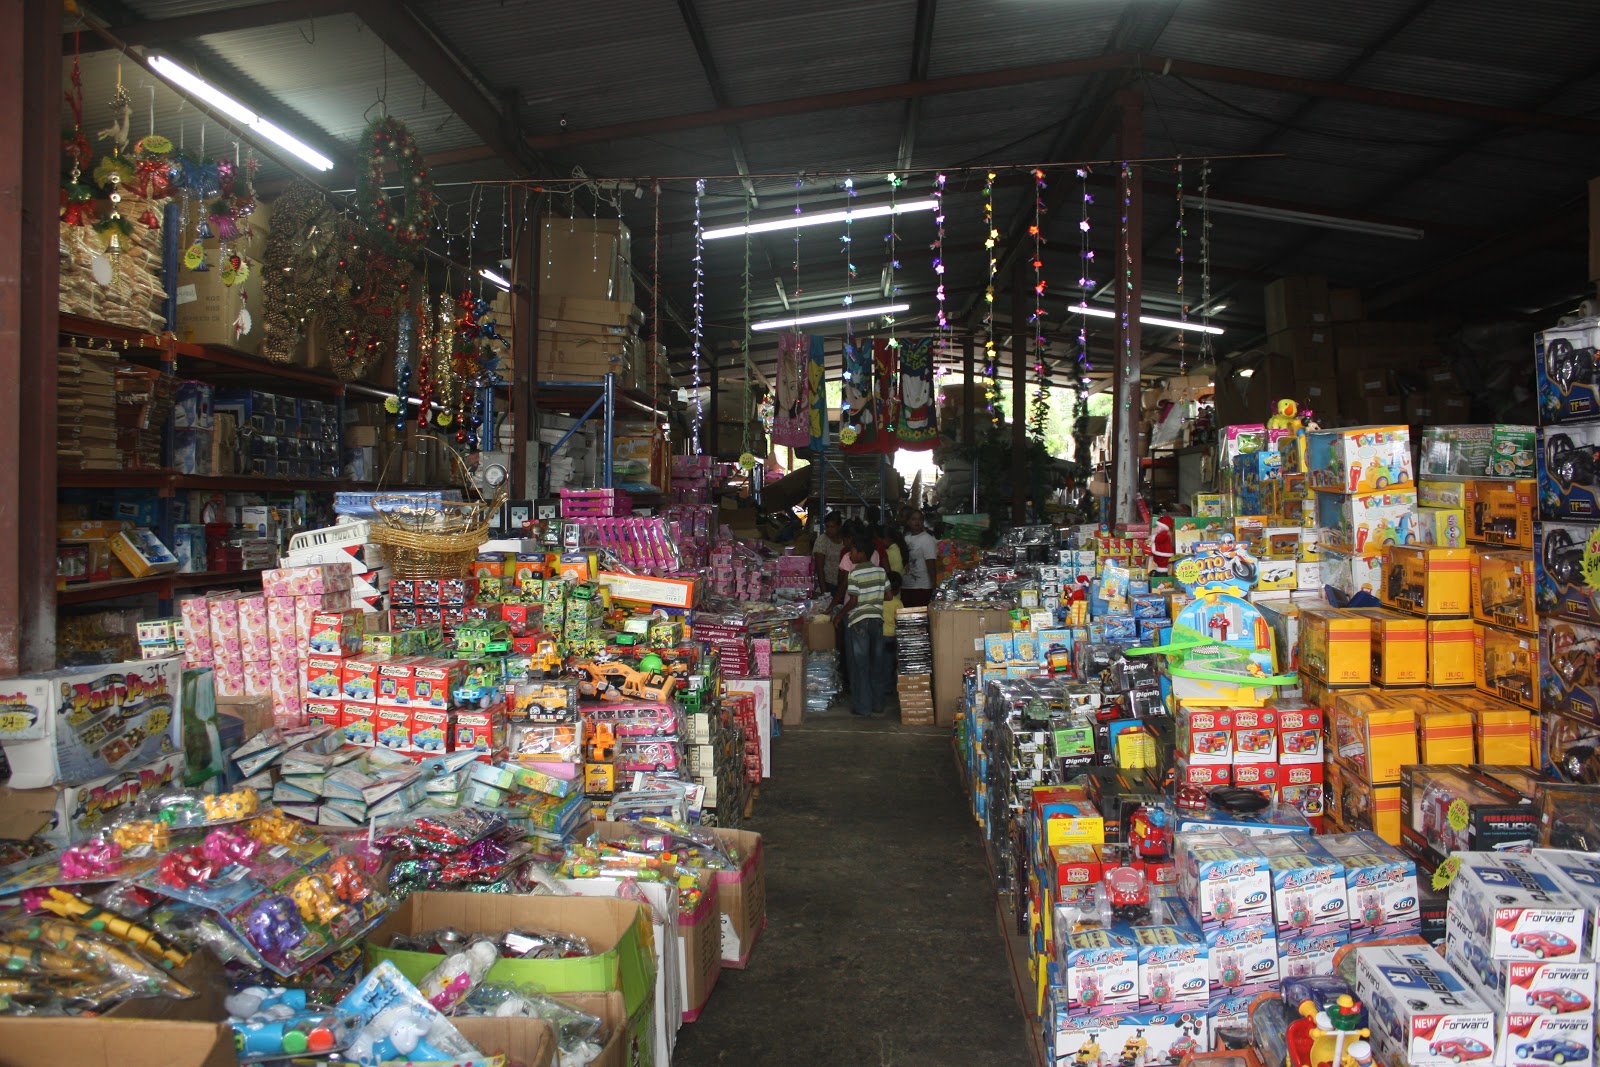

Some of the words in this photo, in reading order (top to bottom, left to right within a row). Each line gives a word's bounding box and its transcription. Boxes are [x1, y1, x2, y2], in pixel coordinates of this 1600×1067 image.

[1195, 556, 1225, 571] OTO
[1198, 570, 1234, 585] GAME
[1123, 663, 1148, 671] Dignity
[1136, 690, 1159, 698] Dignity
[1498, 686, 1521, 703] TRUCK
[3, 717, 14, 728] 24
[1065, 757, 1092, 765] Dignity
[1245, 893, 1264, 904] 360
[1322, 901, 1340, 912] 360
[1394, 900, 1413, 910] 360
[1496, 909, 1519, 920] NEW
[1525, 911, 1576, 923] Forward
[1447, 906, 1473, 940] Forward
[1252, 962, 1271, 971] 360
[1512, 967, 1534, 977] NEW
[1357, 955, 1380, 991] Forward
[1540, 969, 1589, 980] Forward
[1183, 981, 1202, 989] 360
[1402, 953, 1464, 1007] Vanguard
[1112, 982, 1130, 992] 360
[1415, 1018, 1436, 1028] NEW
[1442, 1019, 1489, 1029] Forward
[1510, 1015, 1532, 1025] NEW
[1540, 1019, 1589, 1031] Forward
